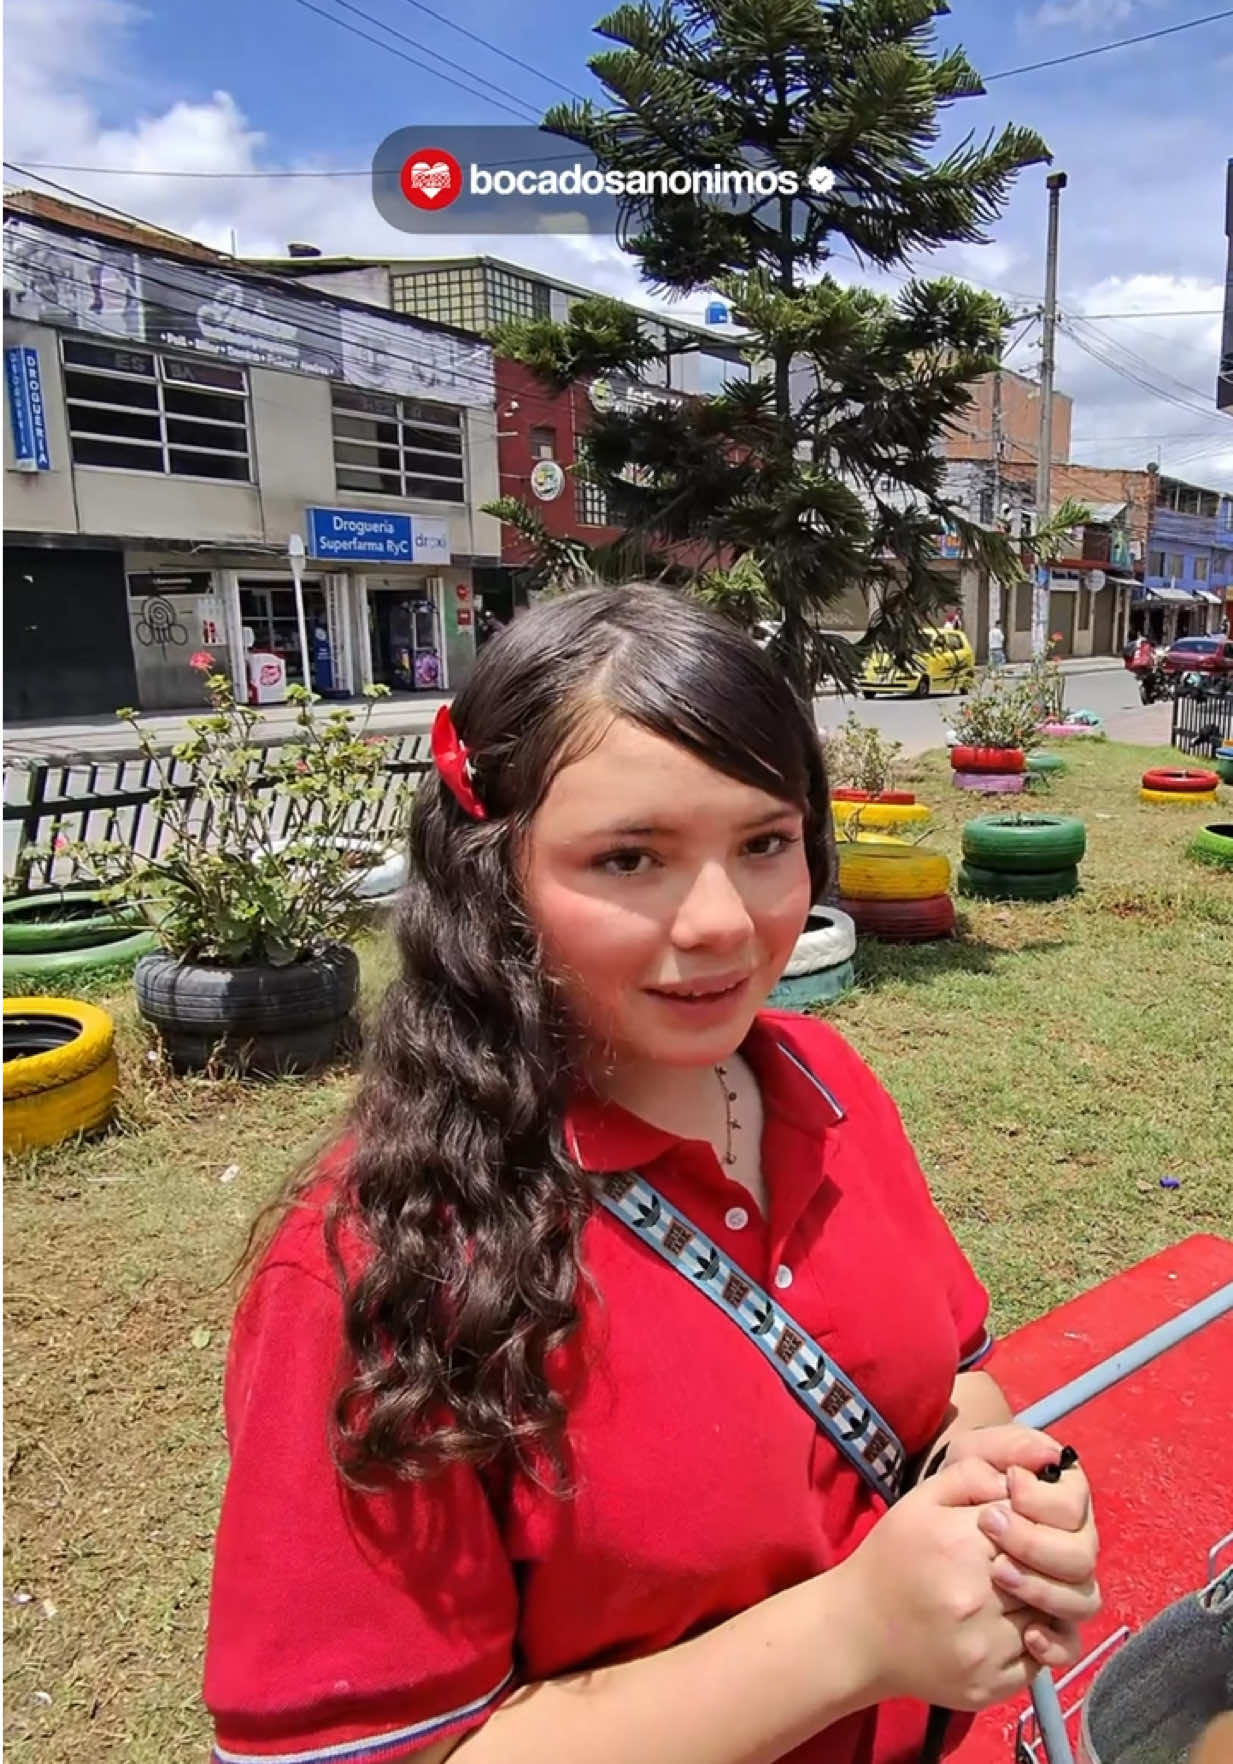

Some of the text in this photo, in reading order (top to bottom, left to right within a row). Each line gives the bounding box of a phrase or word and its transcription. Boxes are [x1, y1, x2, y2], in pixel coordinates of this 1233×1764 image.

[26, 355, 48, 464] DROGUERIA
[319, 536, 409, 555] Superfarma RyC
